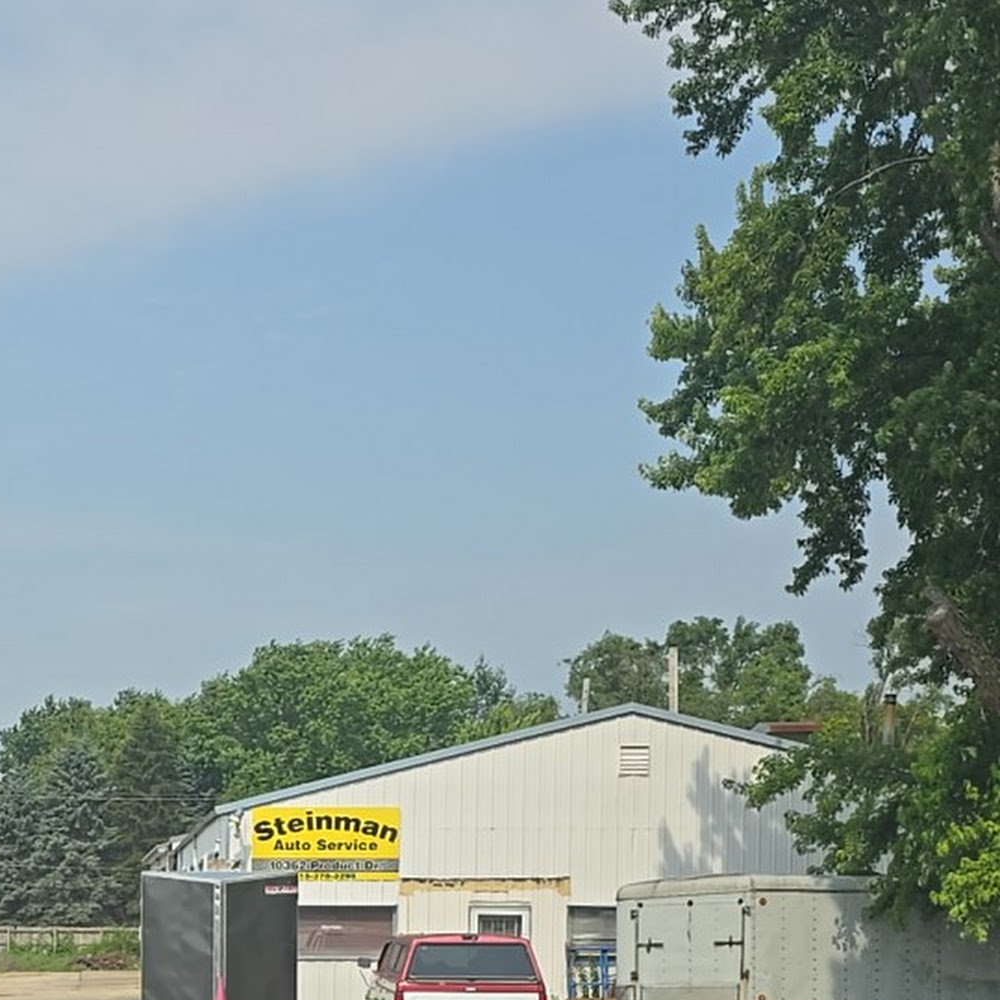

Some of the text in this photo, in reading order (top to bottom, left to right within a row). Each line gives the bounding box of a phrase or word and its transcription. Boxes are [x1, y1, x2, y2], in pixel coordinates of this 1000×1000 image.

[254, 811, 398, 843] Steinman
[274, 839, 378, 851] Auto Service
[311, 861, 360, 870] Product
